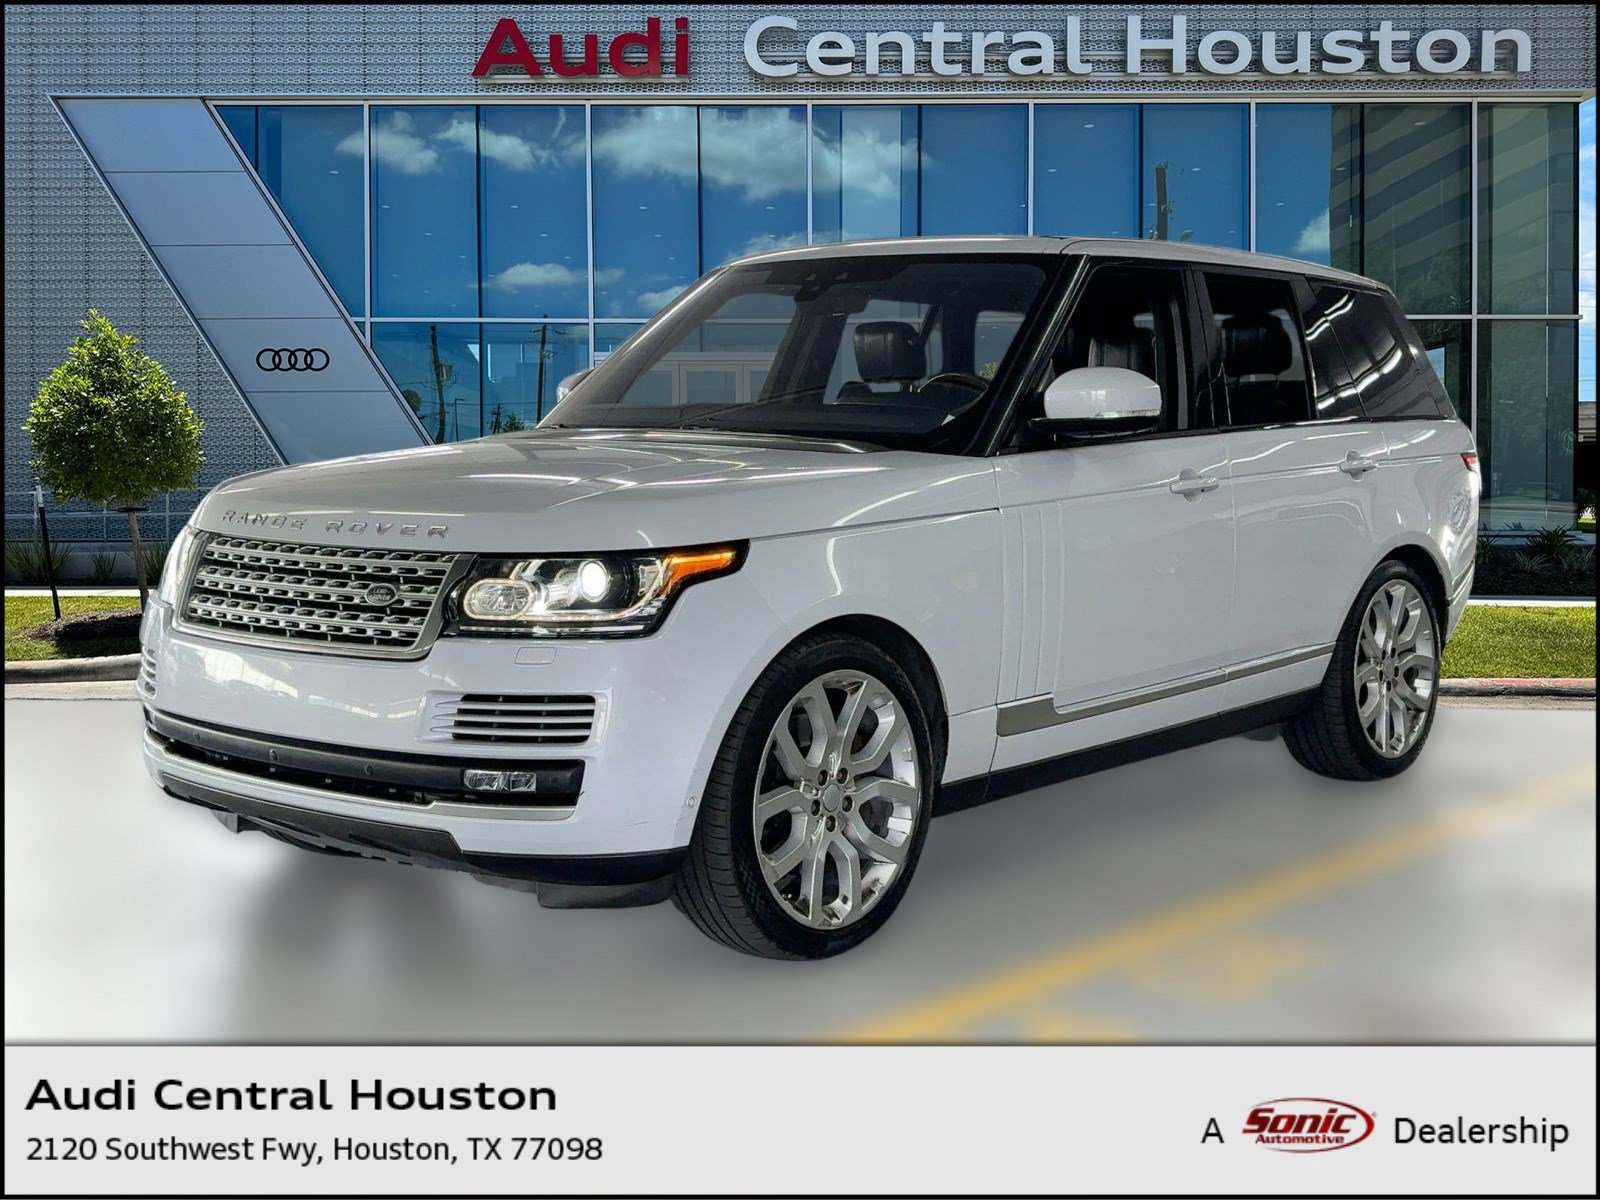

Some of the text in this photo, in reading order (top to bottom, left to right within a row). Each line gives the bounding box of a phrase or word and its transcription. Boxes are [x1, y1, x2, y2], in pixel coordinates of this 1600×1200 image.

[472, 15, 1532, 77] Audi Central Houston
[222, 509, 449, 539] RANGE ROVER
